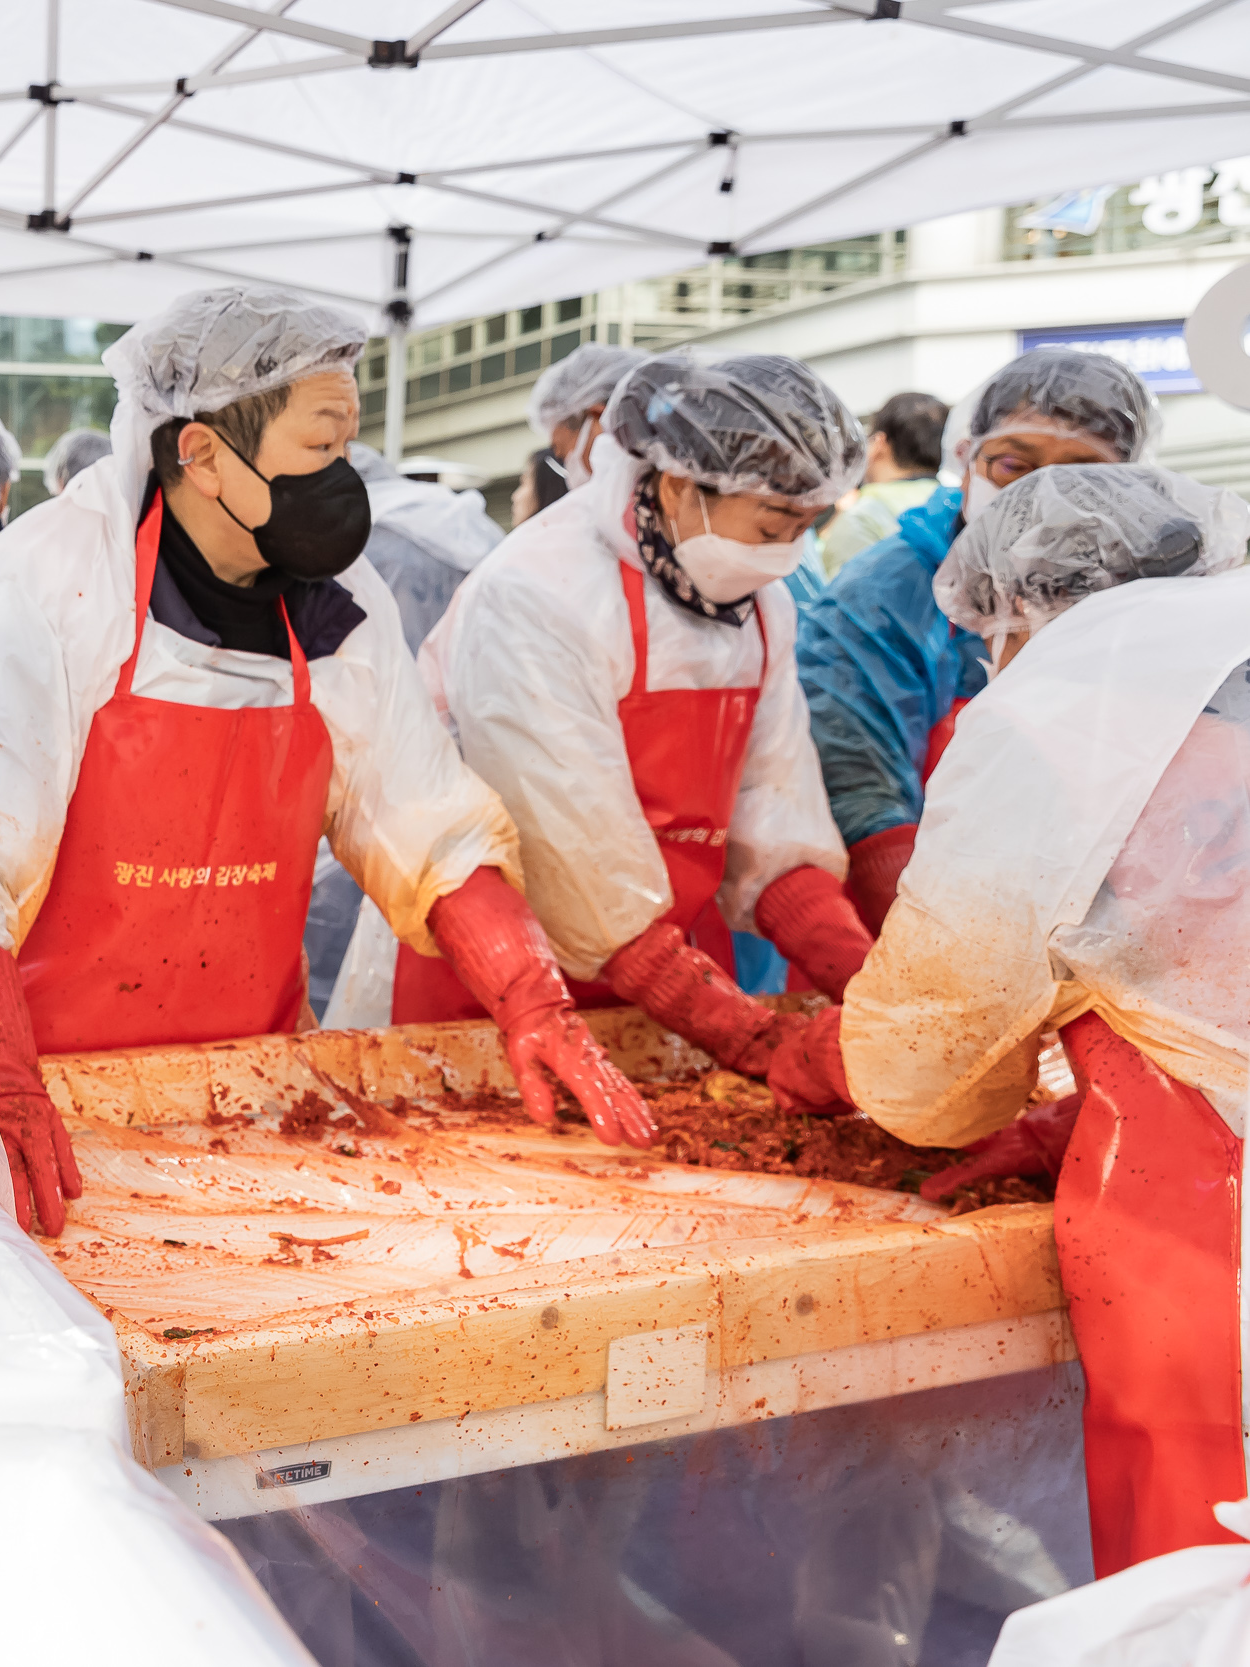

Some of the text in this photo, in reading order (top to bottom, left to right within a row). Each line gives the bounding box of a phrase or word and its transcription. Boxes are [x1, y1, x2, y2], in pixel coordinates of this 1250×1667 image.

[113, 861, 278, 889] 광진 사랑의 김장축제
